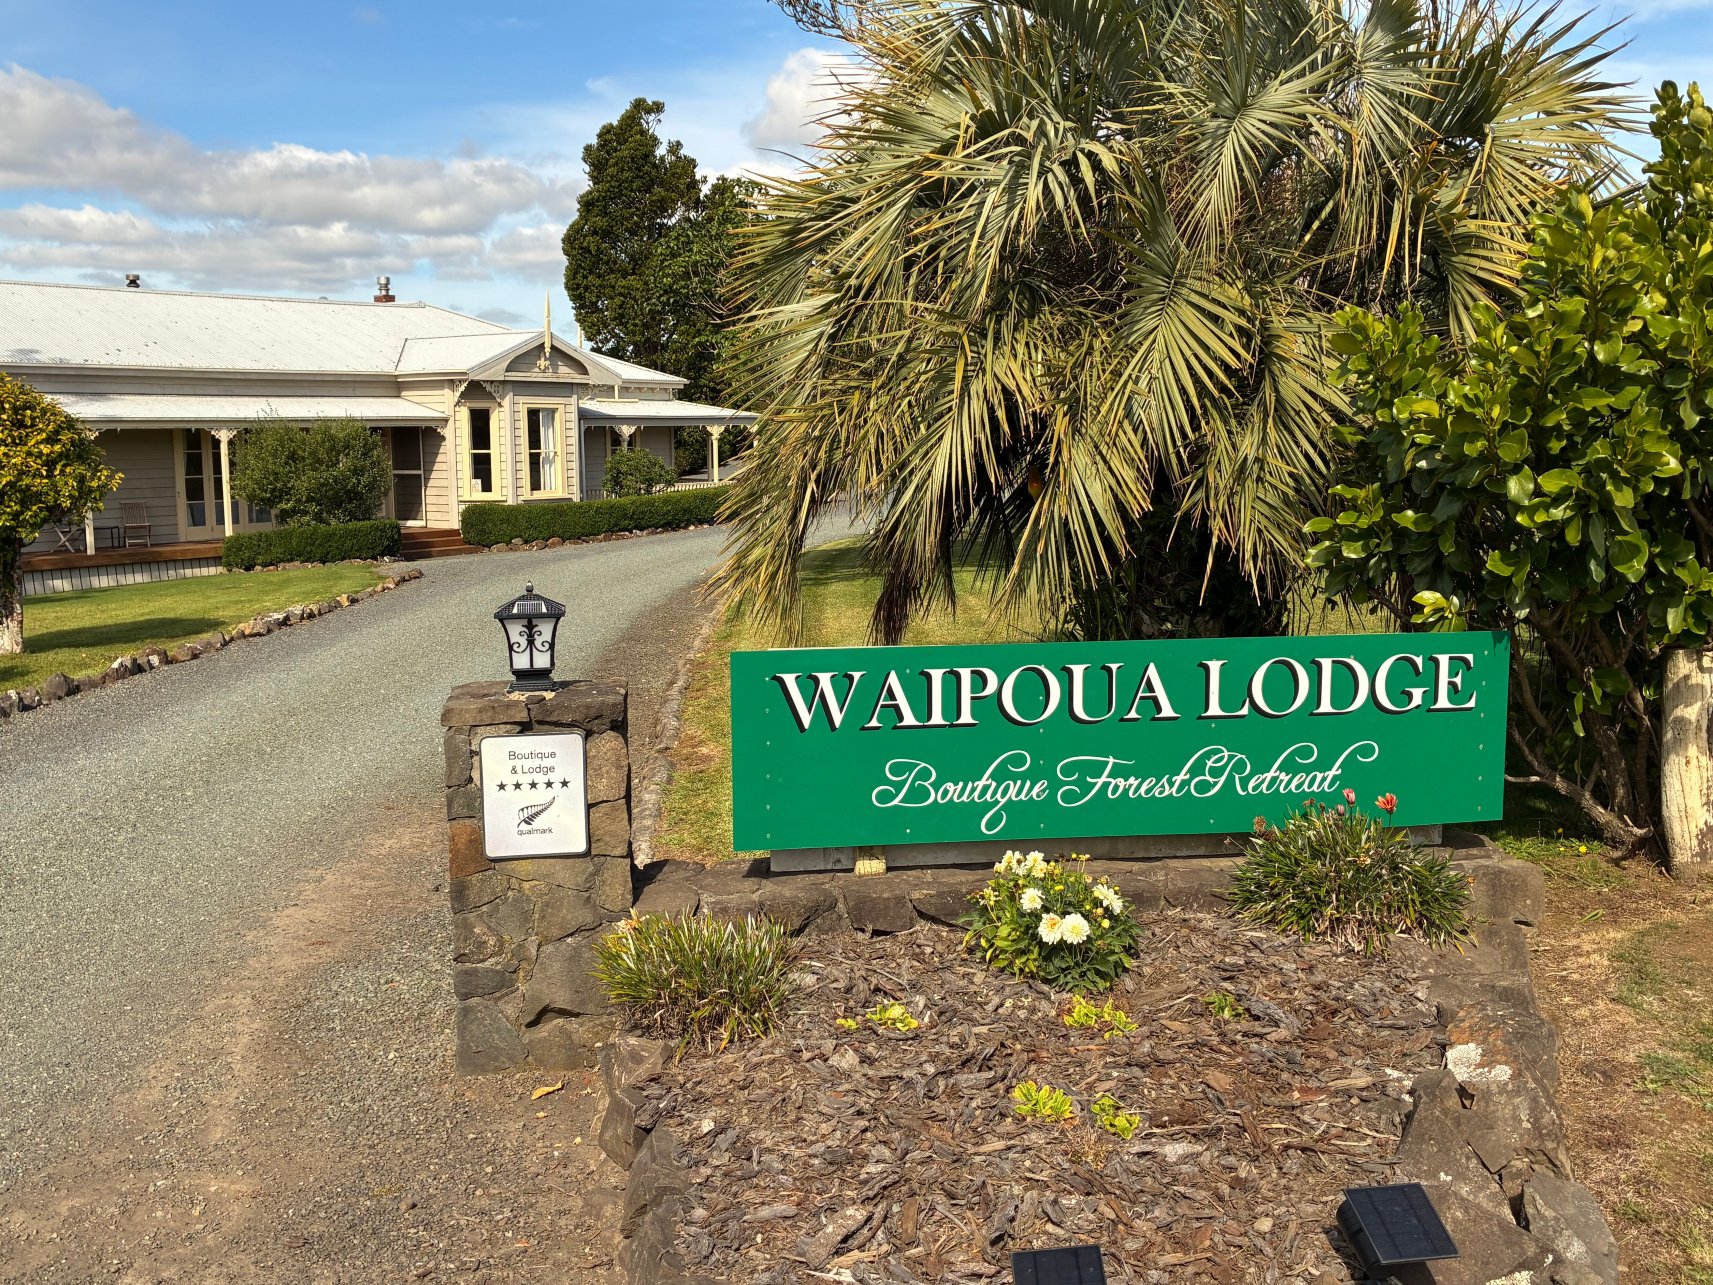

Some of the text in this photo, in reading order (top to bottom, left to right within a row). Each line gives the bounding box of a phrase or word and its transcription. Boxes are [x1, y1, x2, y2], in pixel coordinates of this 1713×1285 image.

[771, 653, 1477, 733] WAIPOUA LODGE
[508, 750, 557, 761] Boutique
[510, 764, 556, 775] & Lodge
[871, 740, 1379, 835] Boutique Forest Retreat
[517, 827, 553, 836] qualmark
